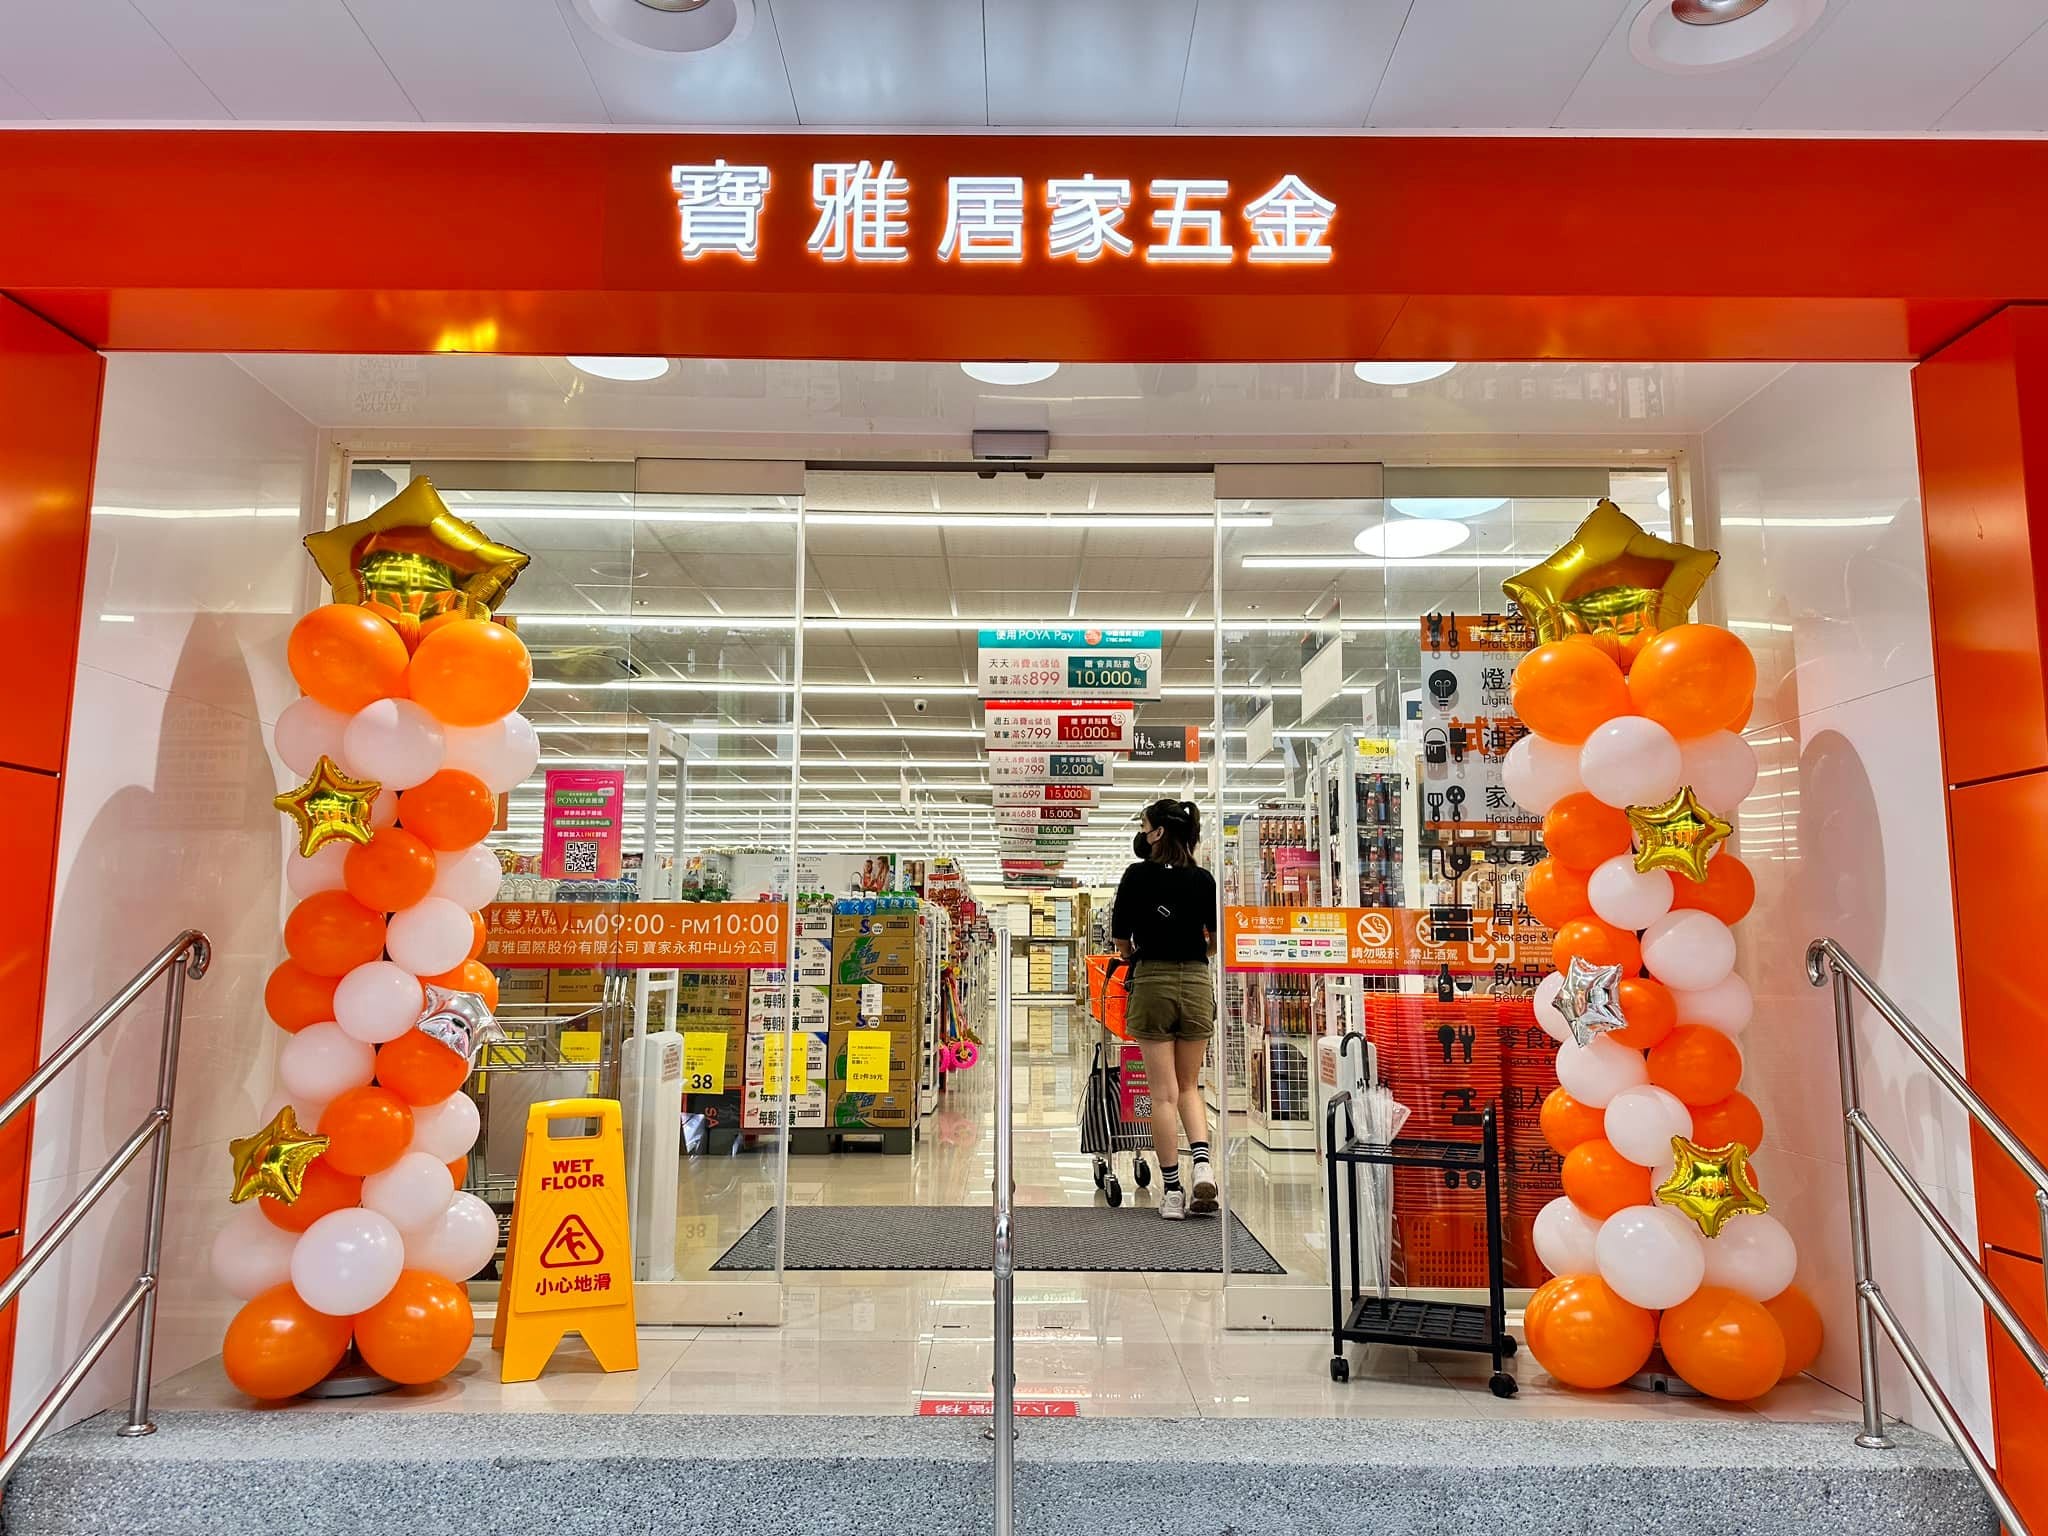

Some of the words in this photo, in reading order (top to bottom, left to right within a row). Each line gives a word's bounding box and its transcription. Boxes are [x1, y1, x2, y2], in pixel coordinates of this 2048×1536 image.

[1488, 872, 1524, 882] Digital
[1251, 916, 1284, 926] 行動支付
[527, 926, 558, 935] HOURS
[1491, 931, 1537, 944] Storage
[1410, 948, 1458, 960] 禁止酒駕
[691, 1074, 713, 1090] 38
[552, 1159, 594, 1174] WET
[541, 1174, 605, 1190] FLOOR
[535, 1273, 611, 1296] 小心地滑
